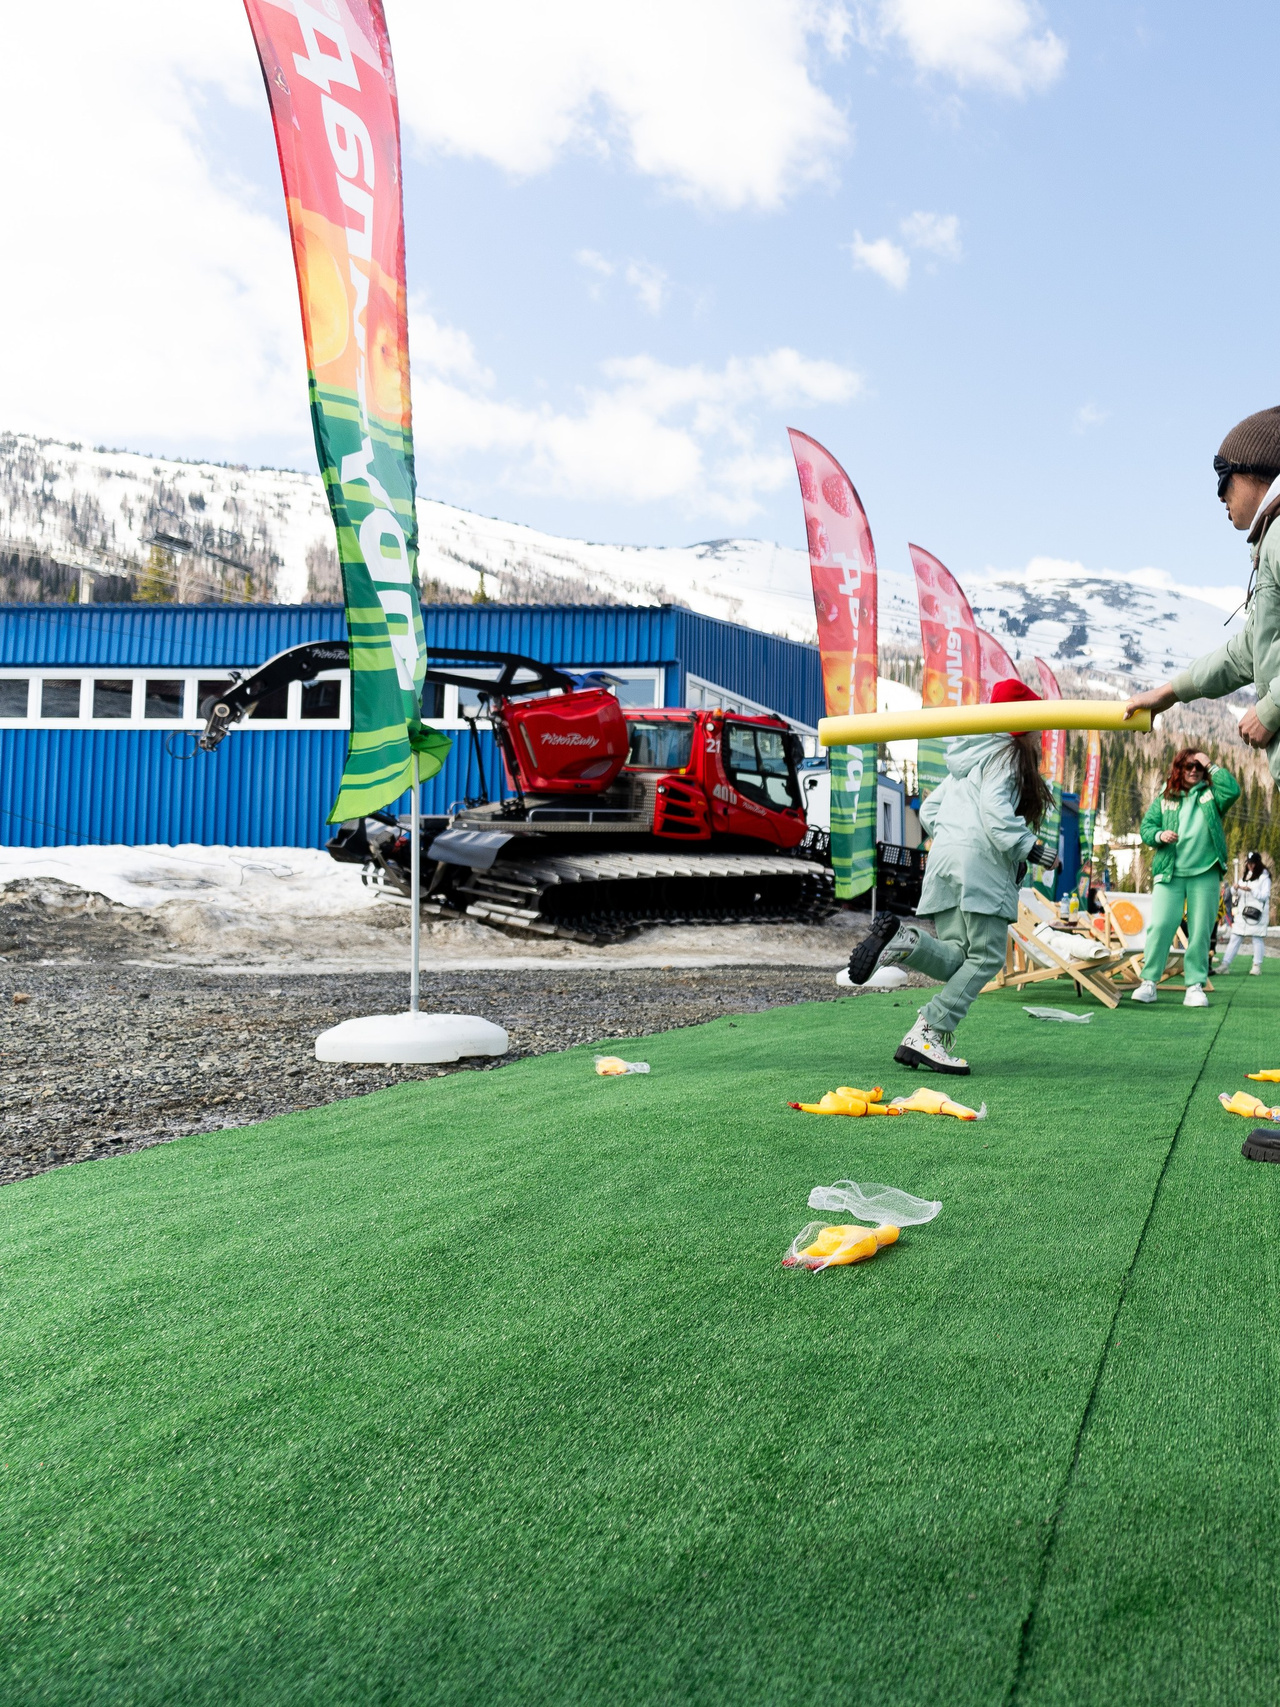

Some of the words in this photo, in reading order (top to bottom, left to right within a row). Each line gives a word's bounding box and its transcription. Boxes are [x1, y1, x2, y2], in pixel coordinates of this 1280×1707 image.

[311, 647, 350, 660] PistonBu
[540, 732, 600, 749] PistonBully
[706, 738, 721, 754] 21
[904, 1037, 918, 1047] CK
